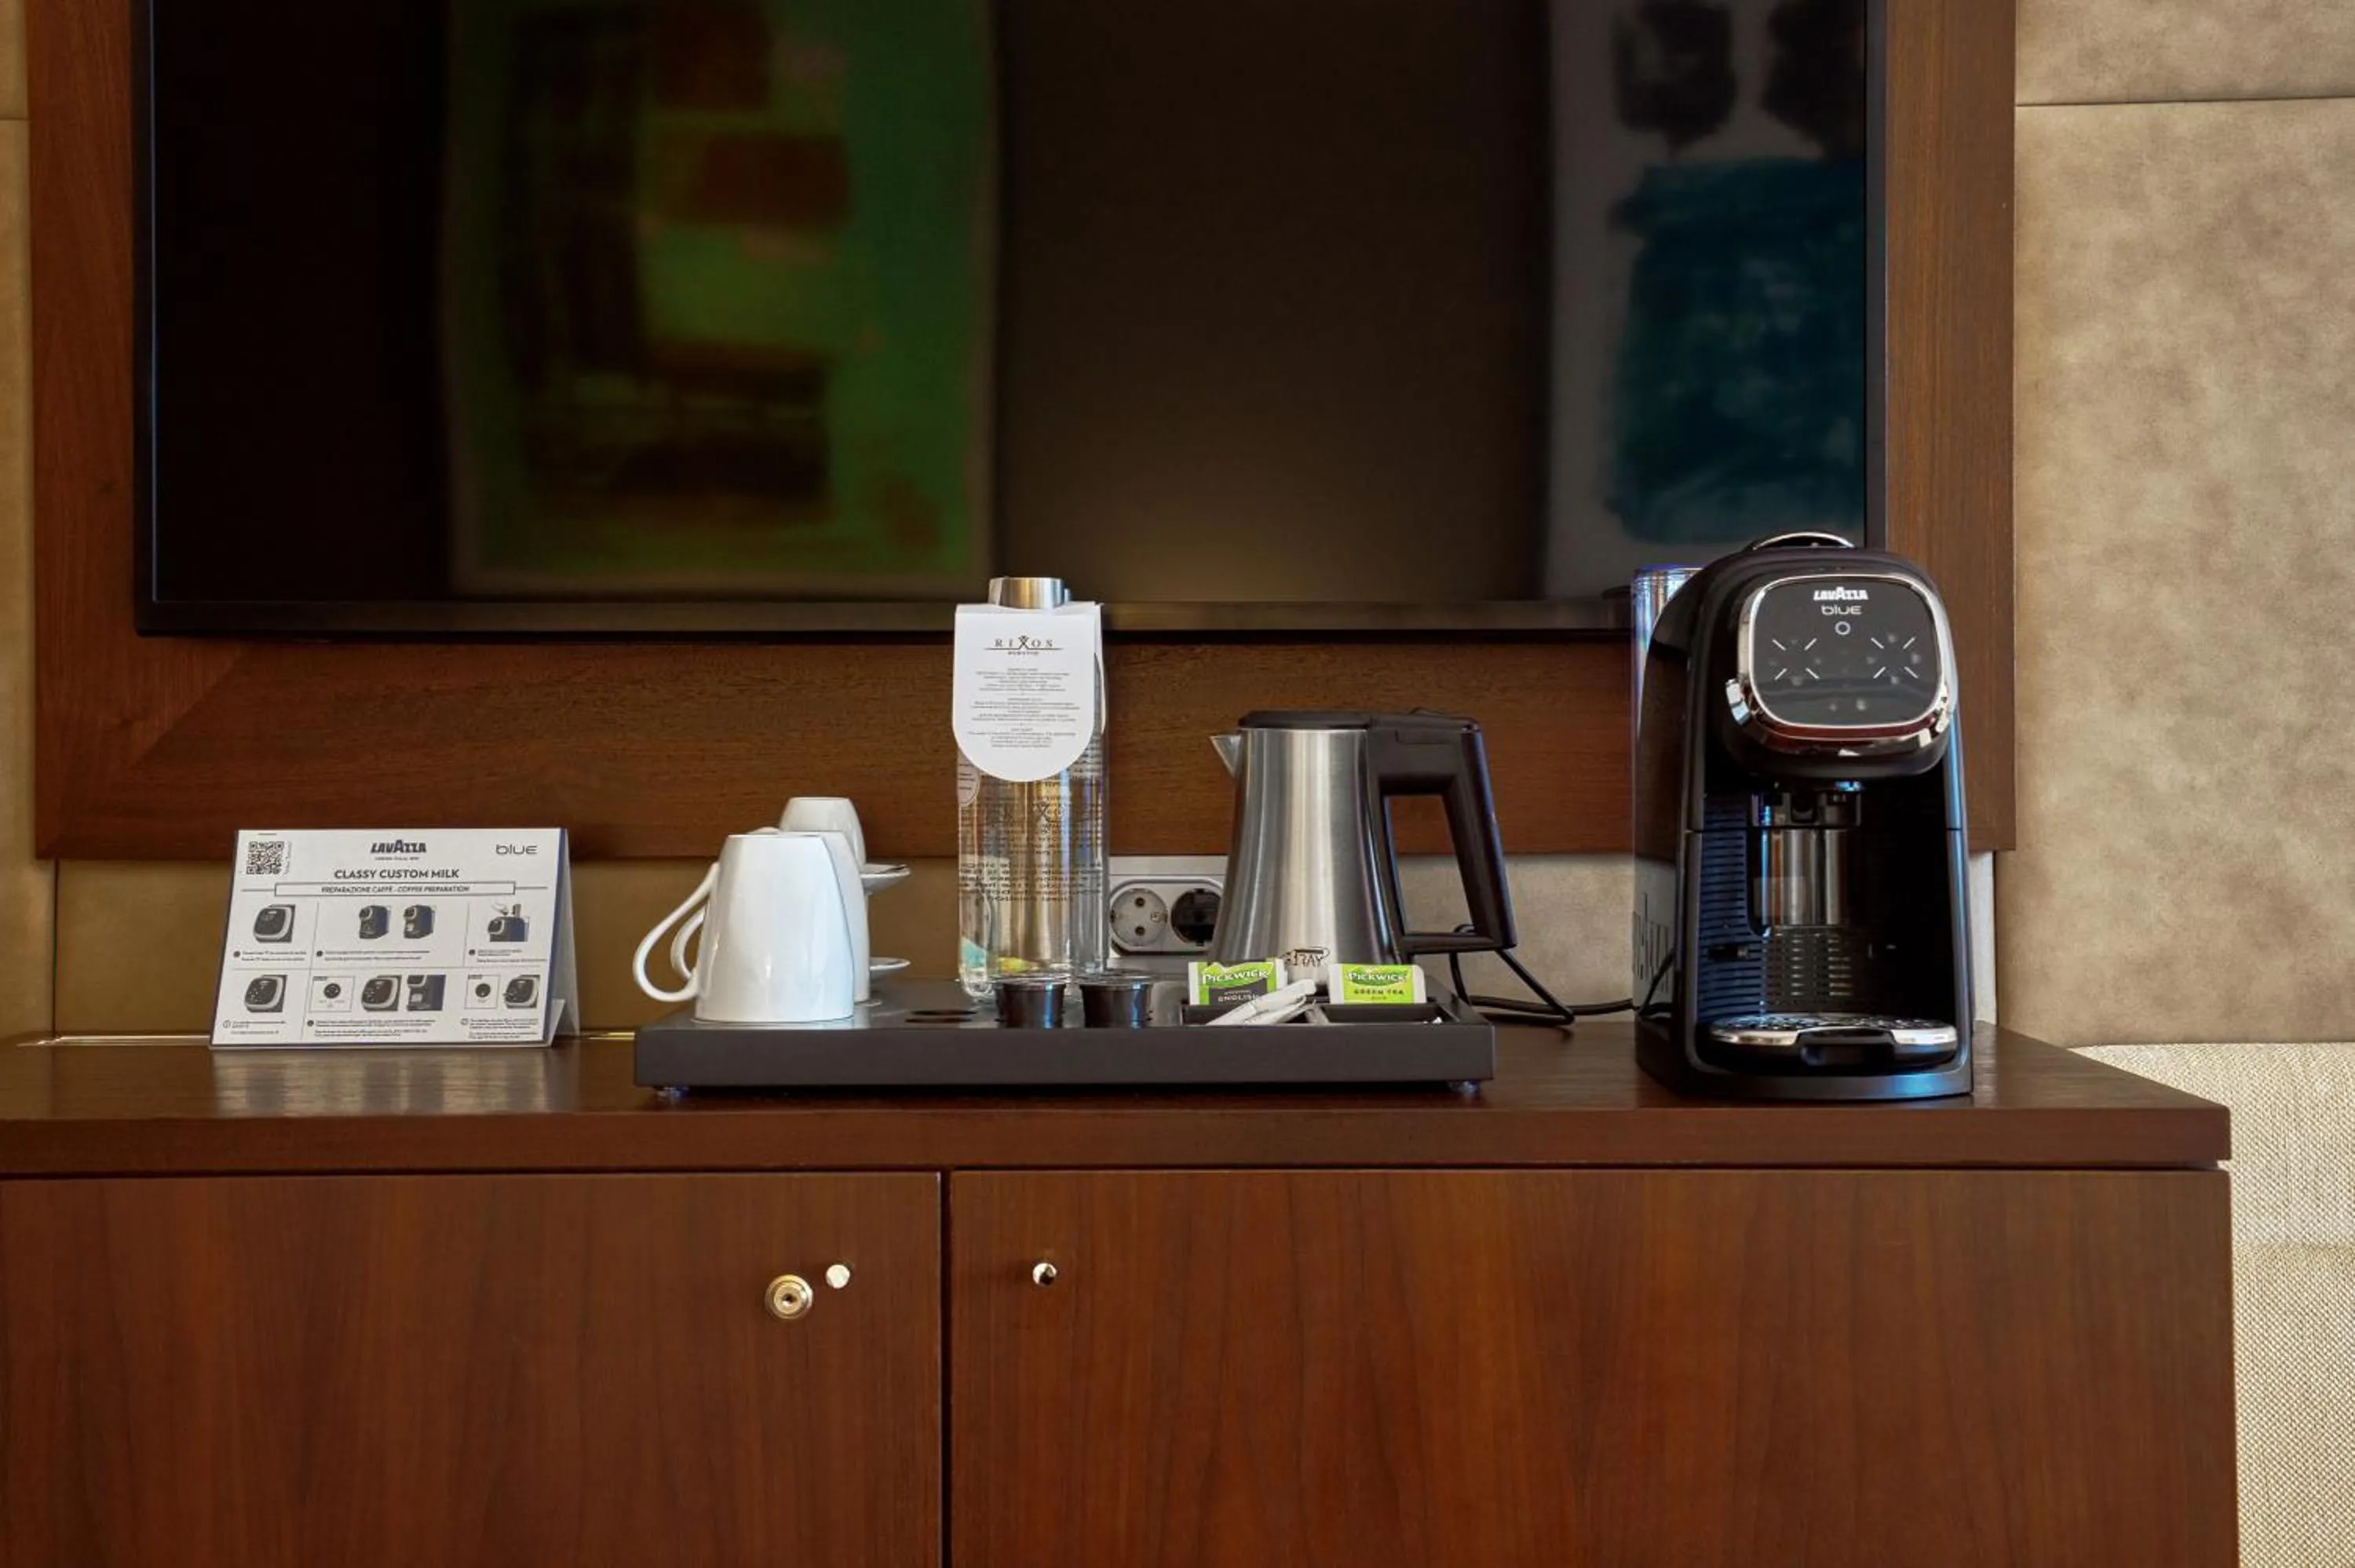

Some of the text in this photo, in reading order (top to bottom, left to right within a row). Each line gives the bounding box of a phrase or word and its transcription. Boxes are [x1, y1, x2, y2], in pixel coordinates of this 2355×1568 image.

[1813, 586, 1869, 601] LAVAZZA
[1821, 605, 1862, 615] blue
[994, 636, 1053, 650] RIXOS
[371, 839, 426, 853] LAVAZZA
[495, 844, 538, 855] blue
[334, 869, 459, 879] CLASSY CUSTOM MILK
[1203, 969, 1269, 986] PICKWICK
